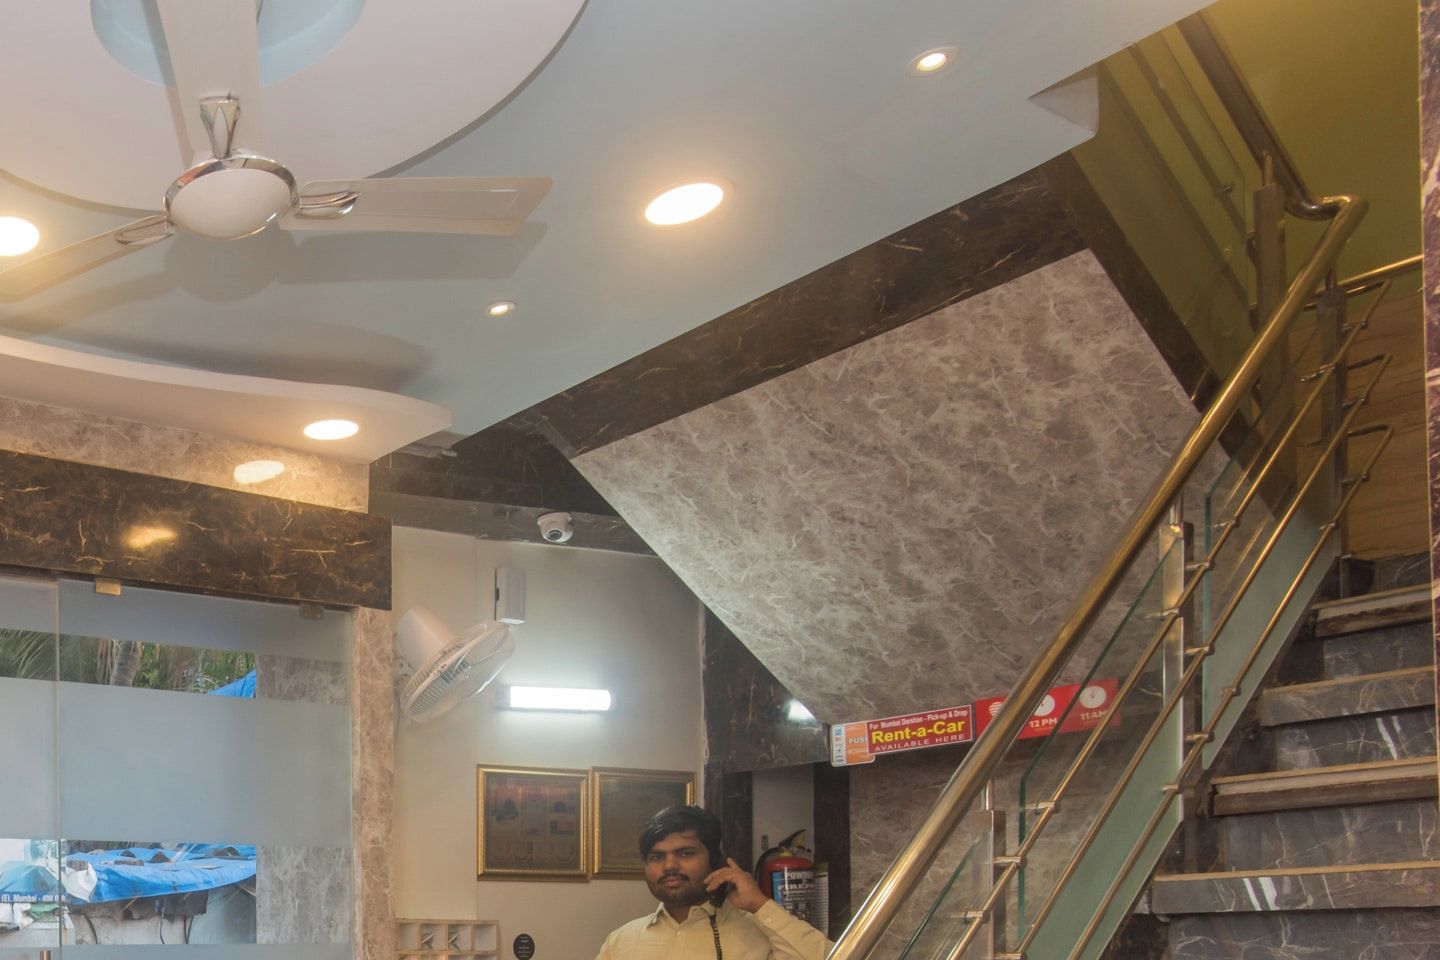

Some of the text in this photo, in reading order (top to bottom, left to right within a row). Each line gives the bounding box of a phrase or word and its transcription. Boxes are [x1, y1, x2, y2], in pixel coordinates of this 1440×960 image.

[1041, 717, 1058, 727] PM
[871, 721, 966, 744] Rent-a-Car
[874, 738, 931, 752] AVAILABLE
[935, 733, 966, 743] HERE
